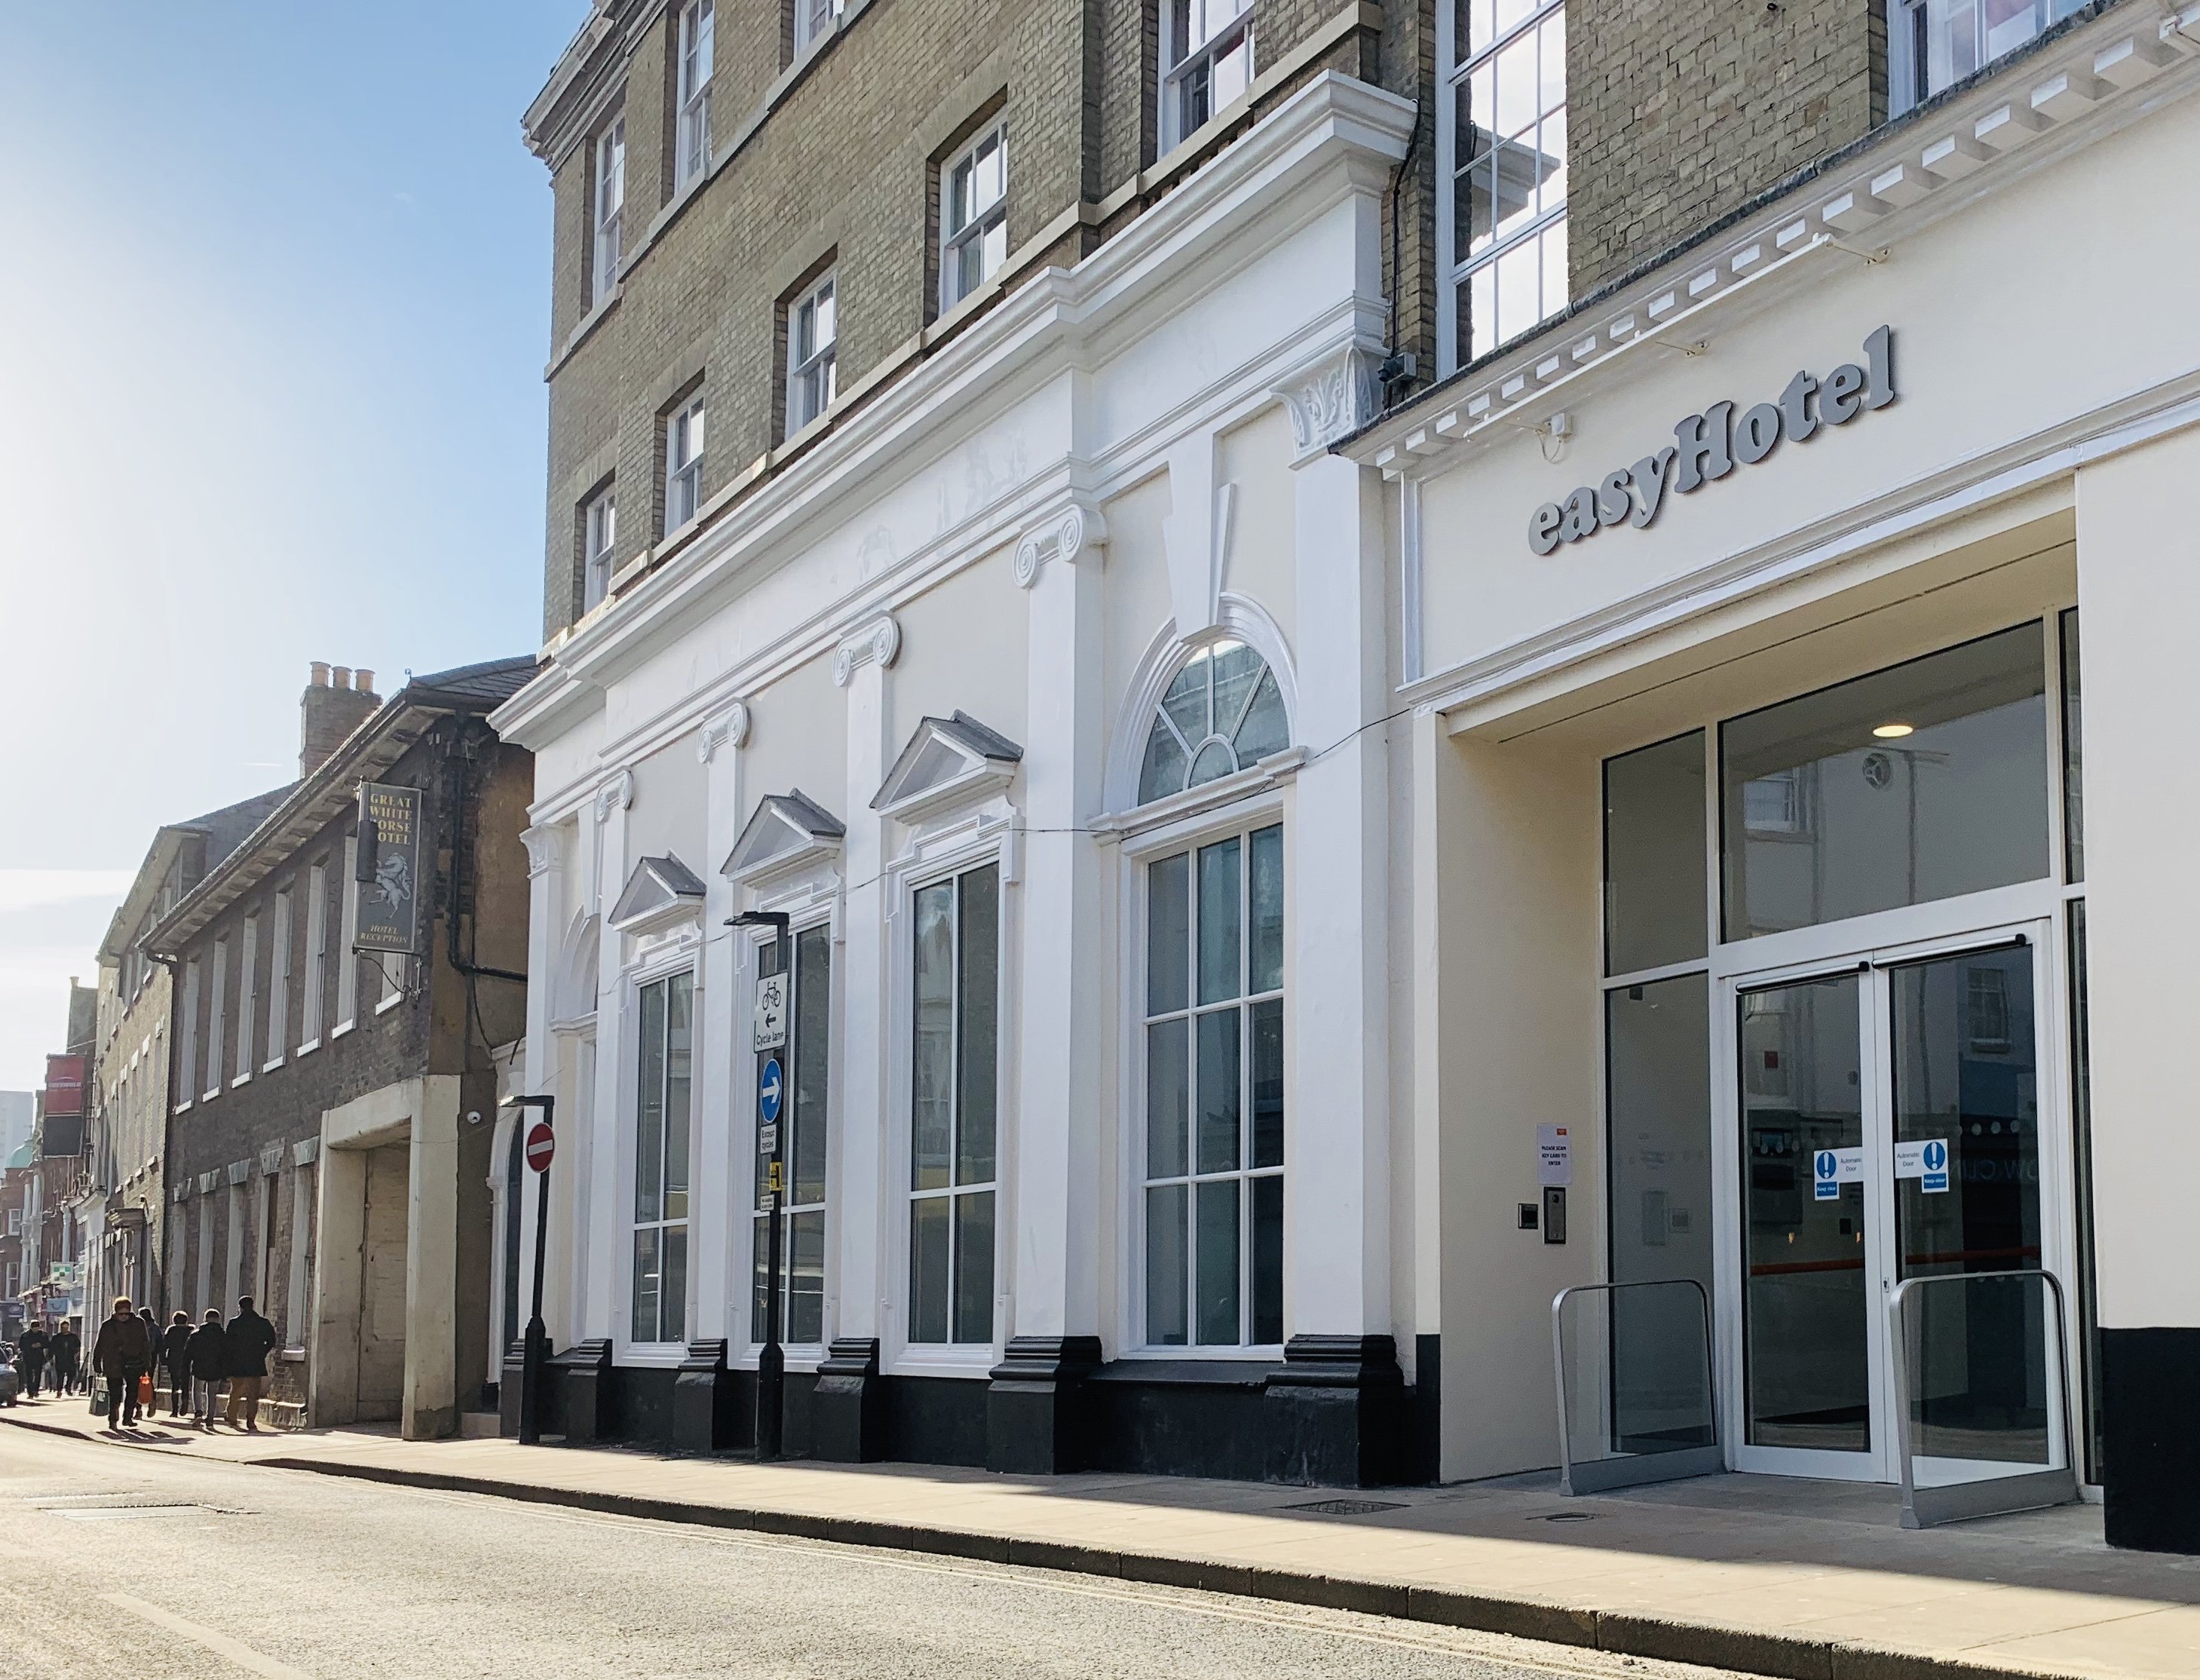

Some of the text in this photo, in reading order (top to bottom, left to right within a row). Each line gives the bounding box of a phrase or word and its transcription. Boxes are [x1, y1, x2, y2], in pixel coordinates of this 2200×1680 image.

[1528, 324, 1895, 556] easyHotel
[370, 793, 411, 808] GREAT
[369, 806, 412, 820] WHITE
[369, 819, 412, 832] ORSE
[378, 832, 410, 845] OTEL
[370, 924, 398, 934] HOTEL
[361, 932, 408, 943] RECEPTION
[756, 1031, 784, 1047] Cycle lane
[761, 1130, 775, 1139] Except
[761, 1141, 774, 1151] cycles
